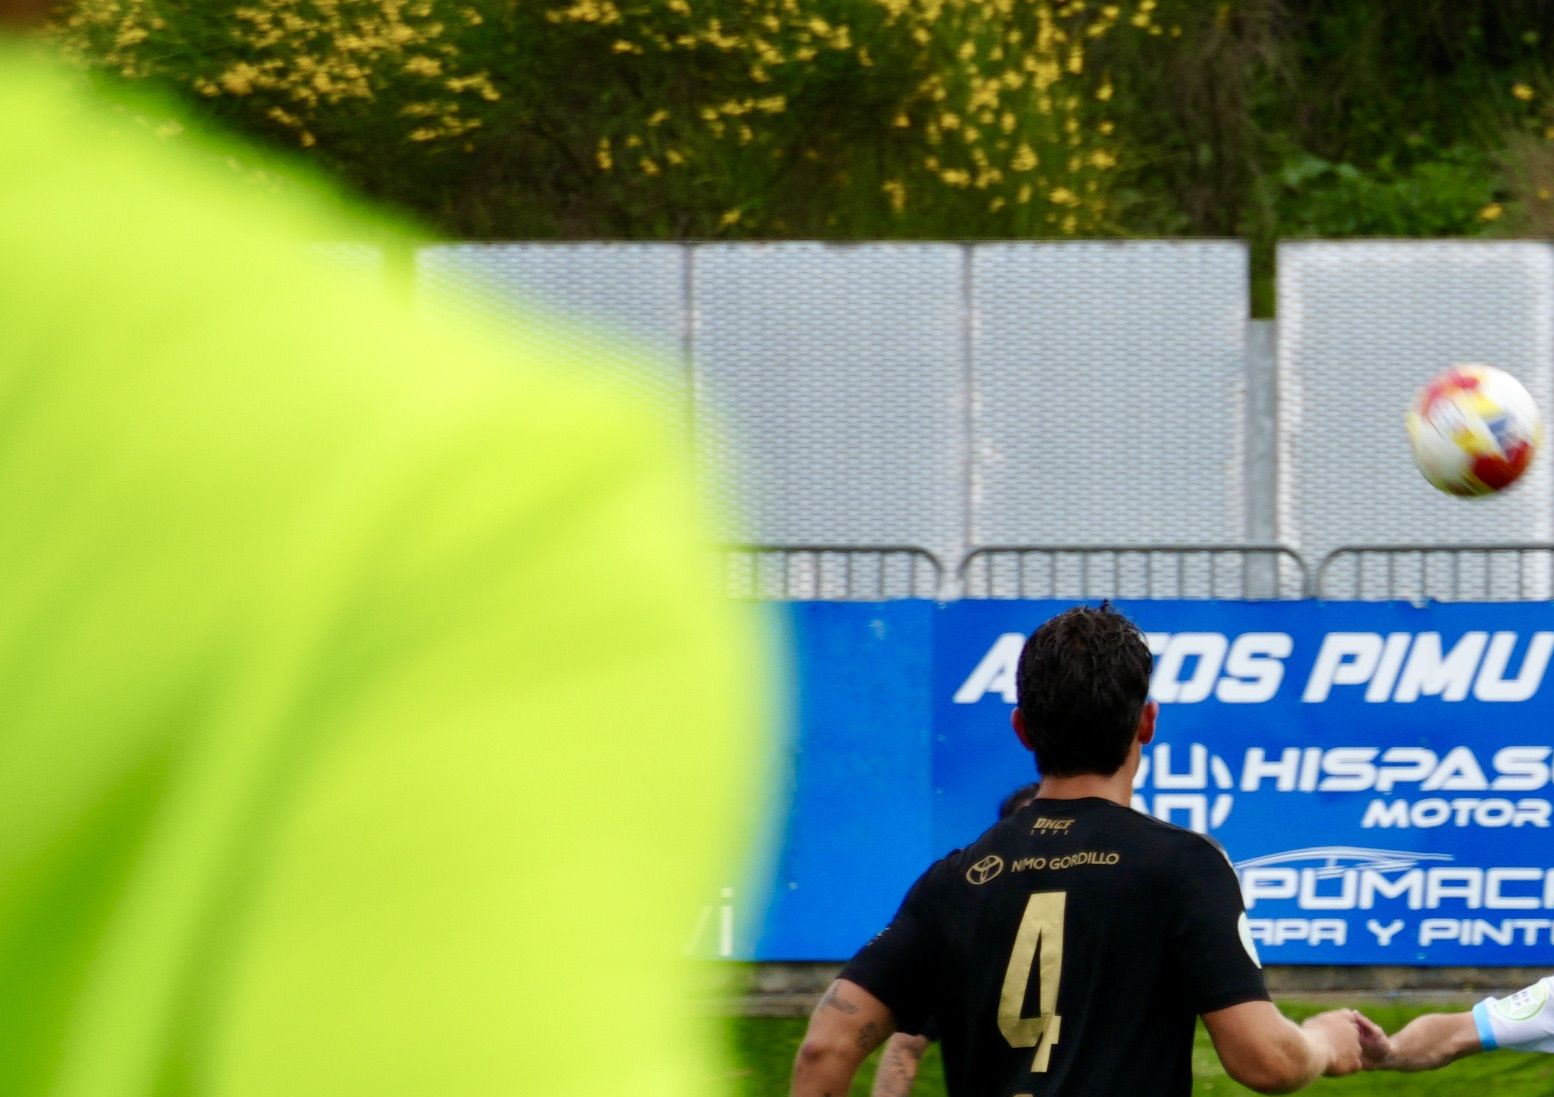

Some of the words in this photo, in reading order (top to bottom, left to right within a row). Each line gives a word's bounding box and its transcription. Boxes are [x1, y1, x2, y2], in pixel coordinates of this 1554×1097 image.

[1361, 798, 1553, 829] MOTOR
[1048, 851, 1120, 870] GORDILLO
[1367, 919, 1404, 947] Y
[997, 891, 1067, 1073] 4
